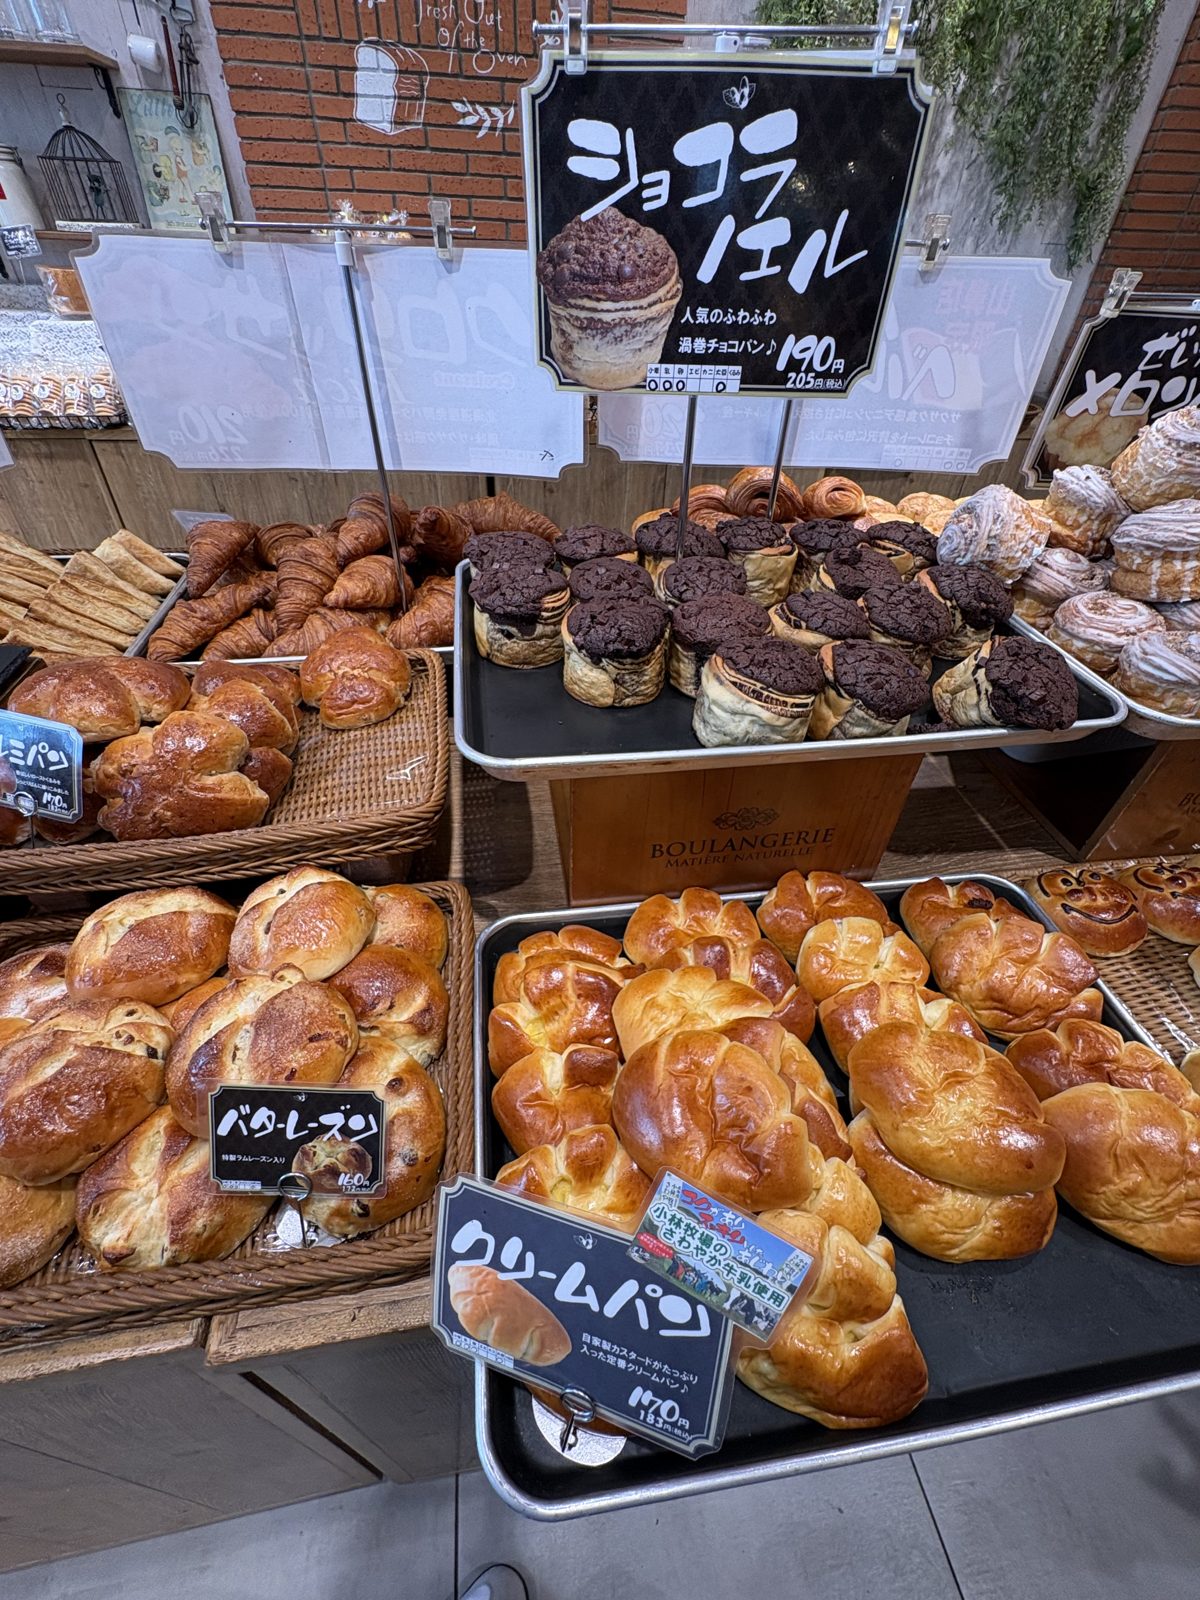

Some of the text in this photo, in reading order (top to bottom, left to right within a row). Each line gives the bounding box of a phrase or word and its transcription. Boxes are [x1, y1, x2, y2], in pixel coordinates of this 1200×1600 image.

[463, 31, 486, 48] the
[472, 49, 528, 74] Oven
[566, 107, 799, 222] ショコラ
[696, 208, 868, 294] ノエル
[680, 306, 777, 325] 人気のふわふわ
[1137, 324, 1200, 372] ぜい
[1065, 369, 1200, 420] メロン
[650, 827, 837, 860] BOULANGERIE
[216, 1103, 379, 1143] バターレーズン
[221, 1153, 287, 1165] 特製ラムレーズン入り
[652, 1204, 730, 1258] 小林牧場の
[450, 1219, 712, 1338] クリームパン
[662, 1226, 786, 1309] さわやか牛乳使用
[580, 1331, 699, 1385] 自家製カスタードがたっぷり
